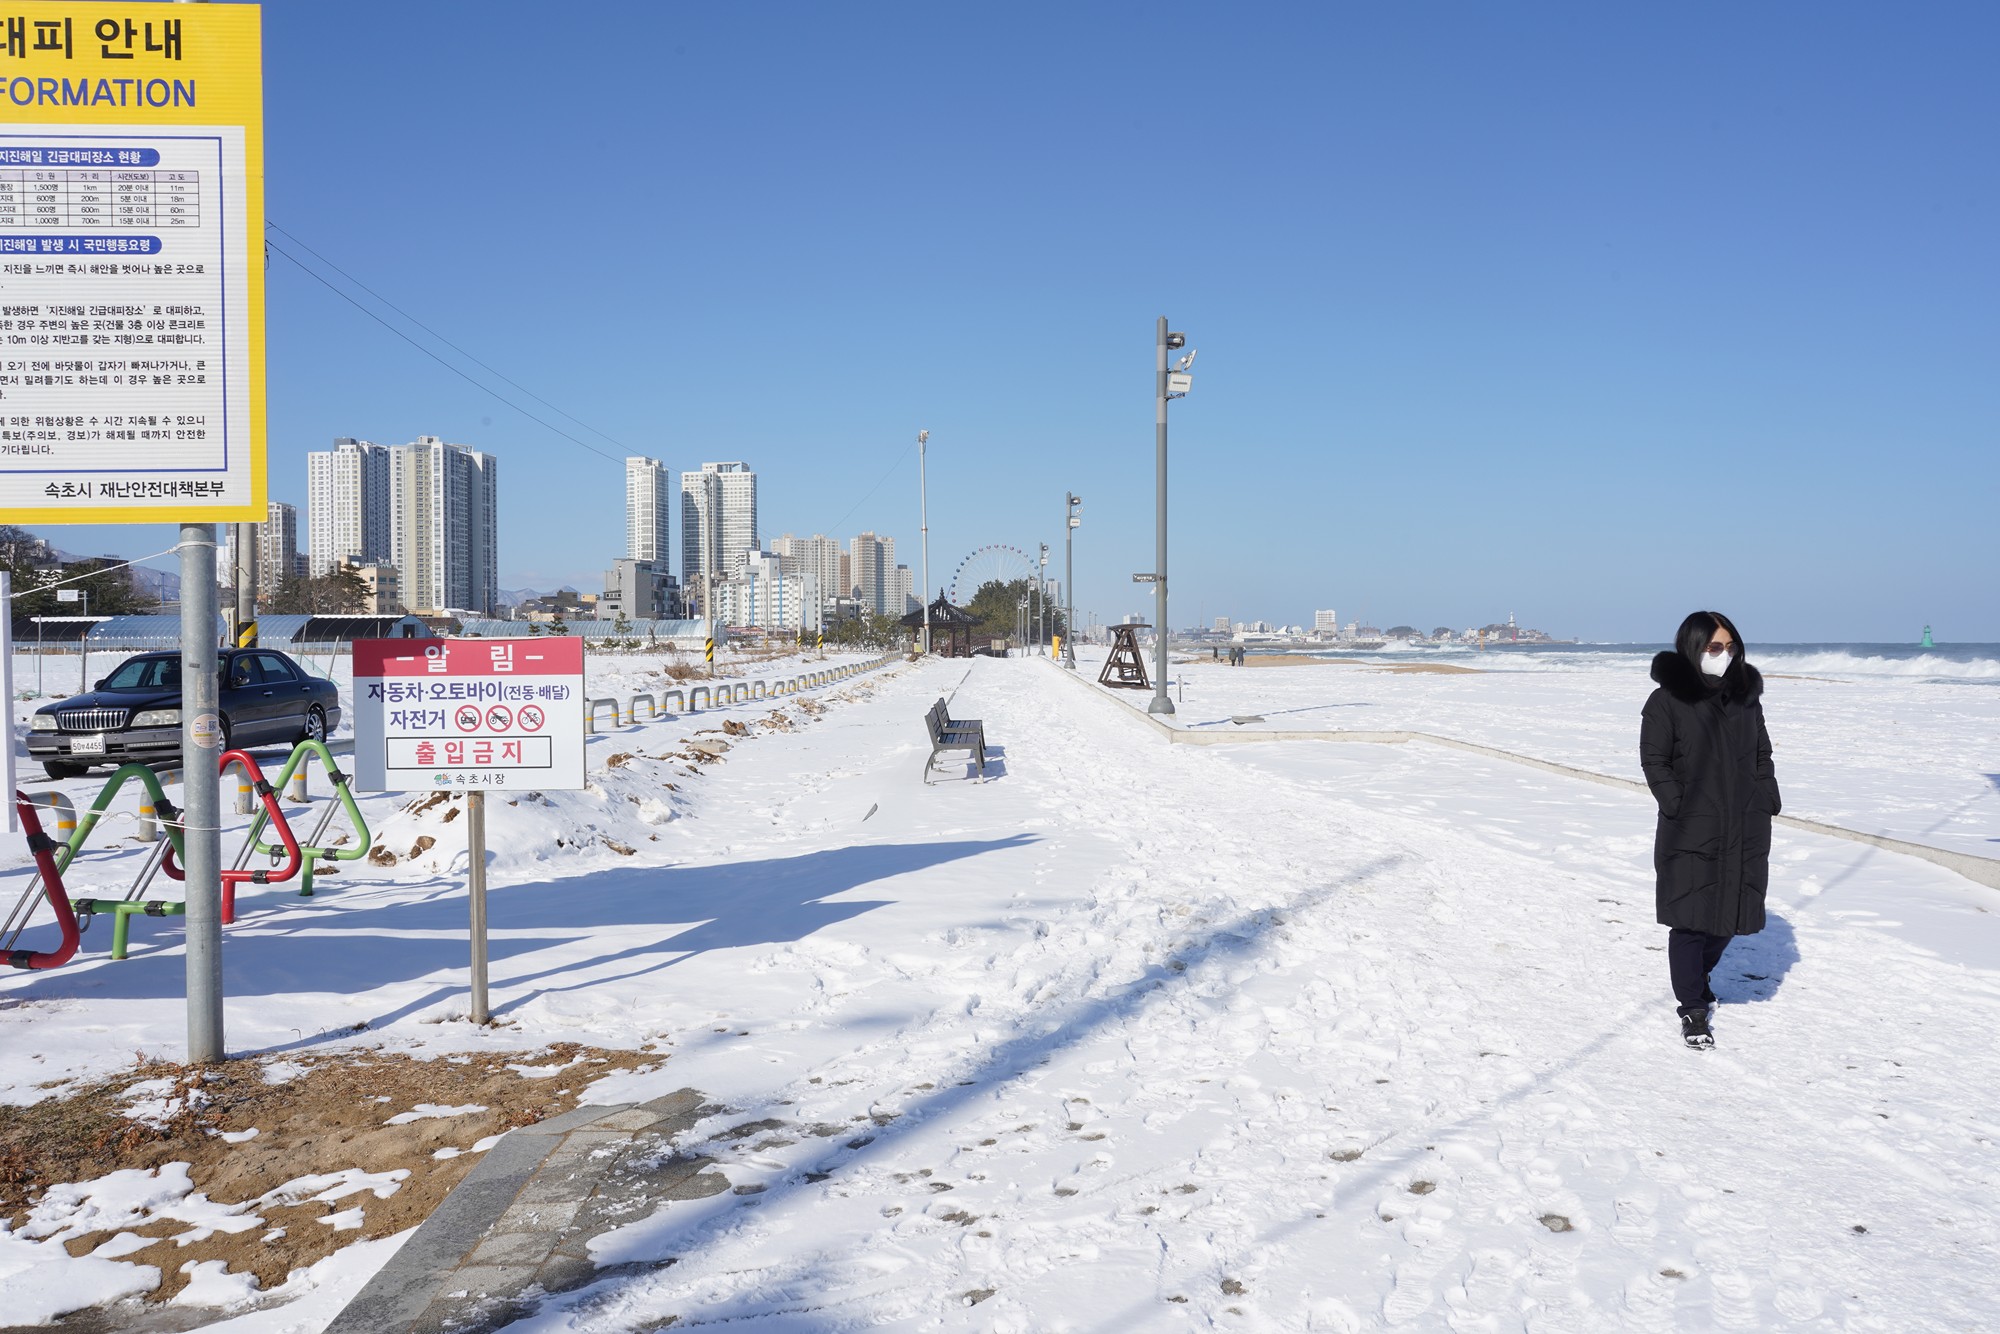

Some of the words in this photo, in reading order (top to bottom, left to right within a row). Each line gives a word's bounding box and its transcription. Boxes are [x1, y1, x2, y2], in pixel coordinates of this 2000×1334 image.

[95, 19, 181, 60] 안내
[48, 151, 114, 163] 긴급대피장소
[119, 151, 141, 164] 현황
[42, 239, 63, 251] 발생
[69, 239, 78, 251] 시
[84, 239, 149, 251] 국민행동요령
[4, 264, 32, 274] 지진을
[36, 264, 63, 274] 느끼면
[68, 265, 86, 274] 즉시
[90, 264, 118, 274] 해안을
[122, 265, 150, 274] 벗어나
[154, 264, 172, 274] 높은
[176, 265, 204, 274] 곳으로
[3, 306, 38, 316] 발생하면
[166, 306, 204, 315] 대피하고,
[17, 320, 35, 330] 경우
[39, 320, 66, 330] 주변의
[71, 320, 89, 330] 높은
[93, 320, 124, 330] 곳(건물
[128, 320, 142, 330] 3층
[147, 320, 165, 330] 이상
[169, 320, 205, 329] 콘크리트
[7, 335, 26, 344] 10m
[31, 335, 49, 345] 이상
[53, 335, 88, 344] 지반고를
[93, 335, 110, 344] 갖는
[115, 335, 153, 344] 지형)으로
[158, 334, 205, 344] 대피합니다.
[8, 361, 25, 371] 오기
[32, 361, 49, 371] 전에
[55, 361, 92, 371] 바닷물이
[98, 361, 125, 371] 갑자기
[131, 361, 192, 371] 빠져나가거나,
[25, 376, 73, 385] 밀려들기도
[79, 375, 107, 385] 하는데
[129, 375, 147, 385] 경우
[153, 375, 171, 384] 높은
[177, 375, 205, 384] 곳으로
[11, 417, 29, 426] 의한
[36, 416, 84, 426] 위험상황은
[104, 416, 123, 426] 시간
[129, 416, 156, 425] 지속될
[177, 416, 204, 425] 있으니
[2, 431, 60, 440] 특보(주의보,
[67, 431, 100, 440] 경보)가
[106, 431, 135, 440] 해제될
[141, 430, 170, 439] 때까지
[176, 430, 205, 439] 안전한
[2, 445, 54, 455] 기다립니다.
[45, 482, 91, 498] 속초시
[100, 481, 225, 498] 재난안전대책본부
[390, 709, 446, 730] 자전거
[415, 740, 522, 765] 출입금지
